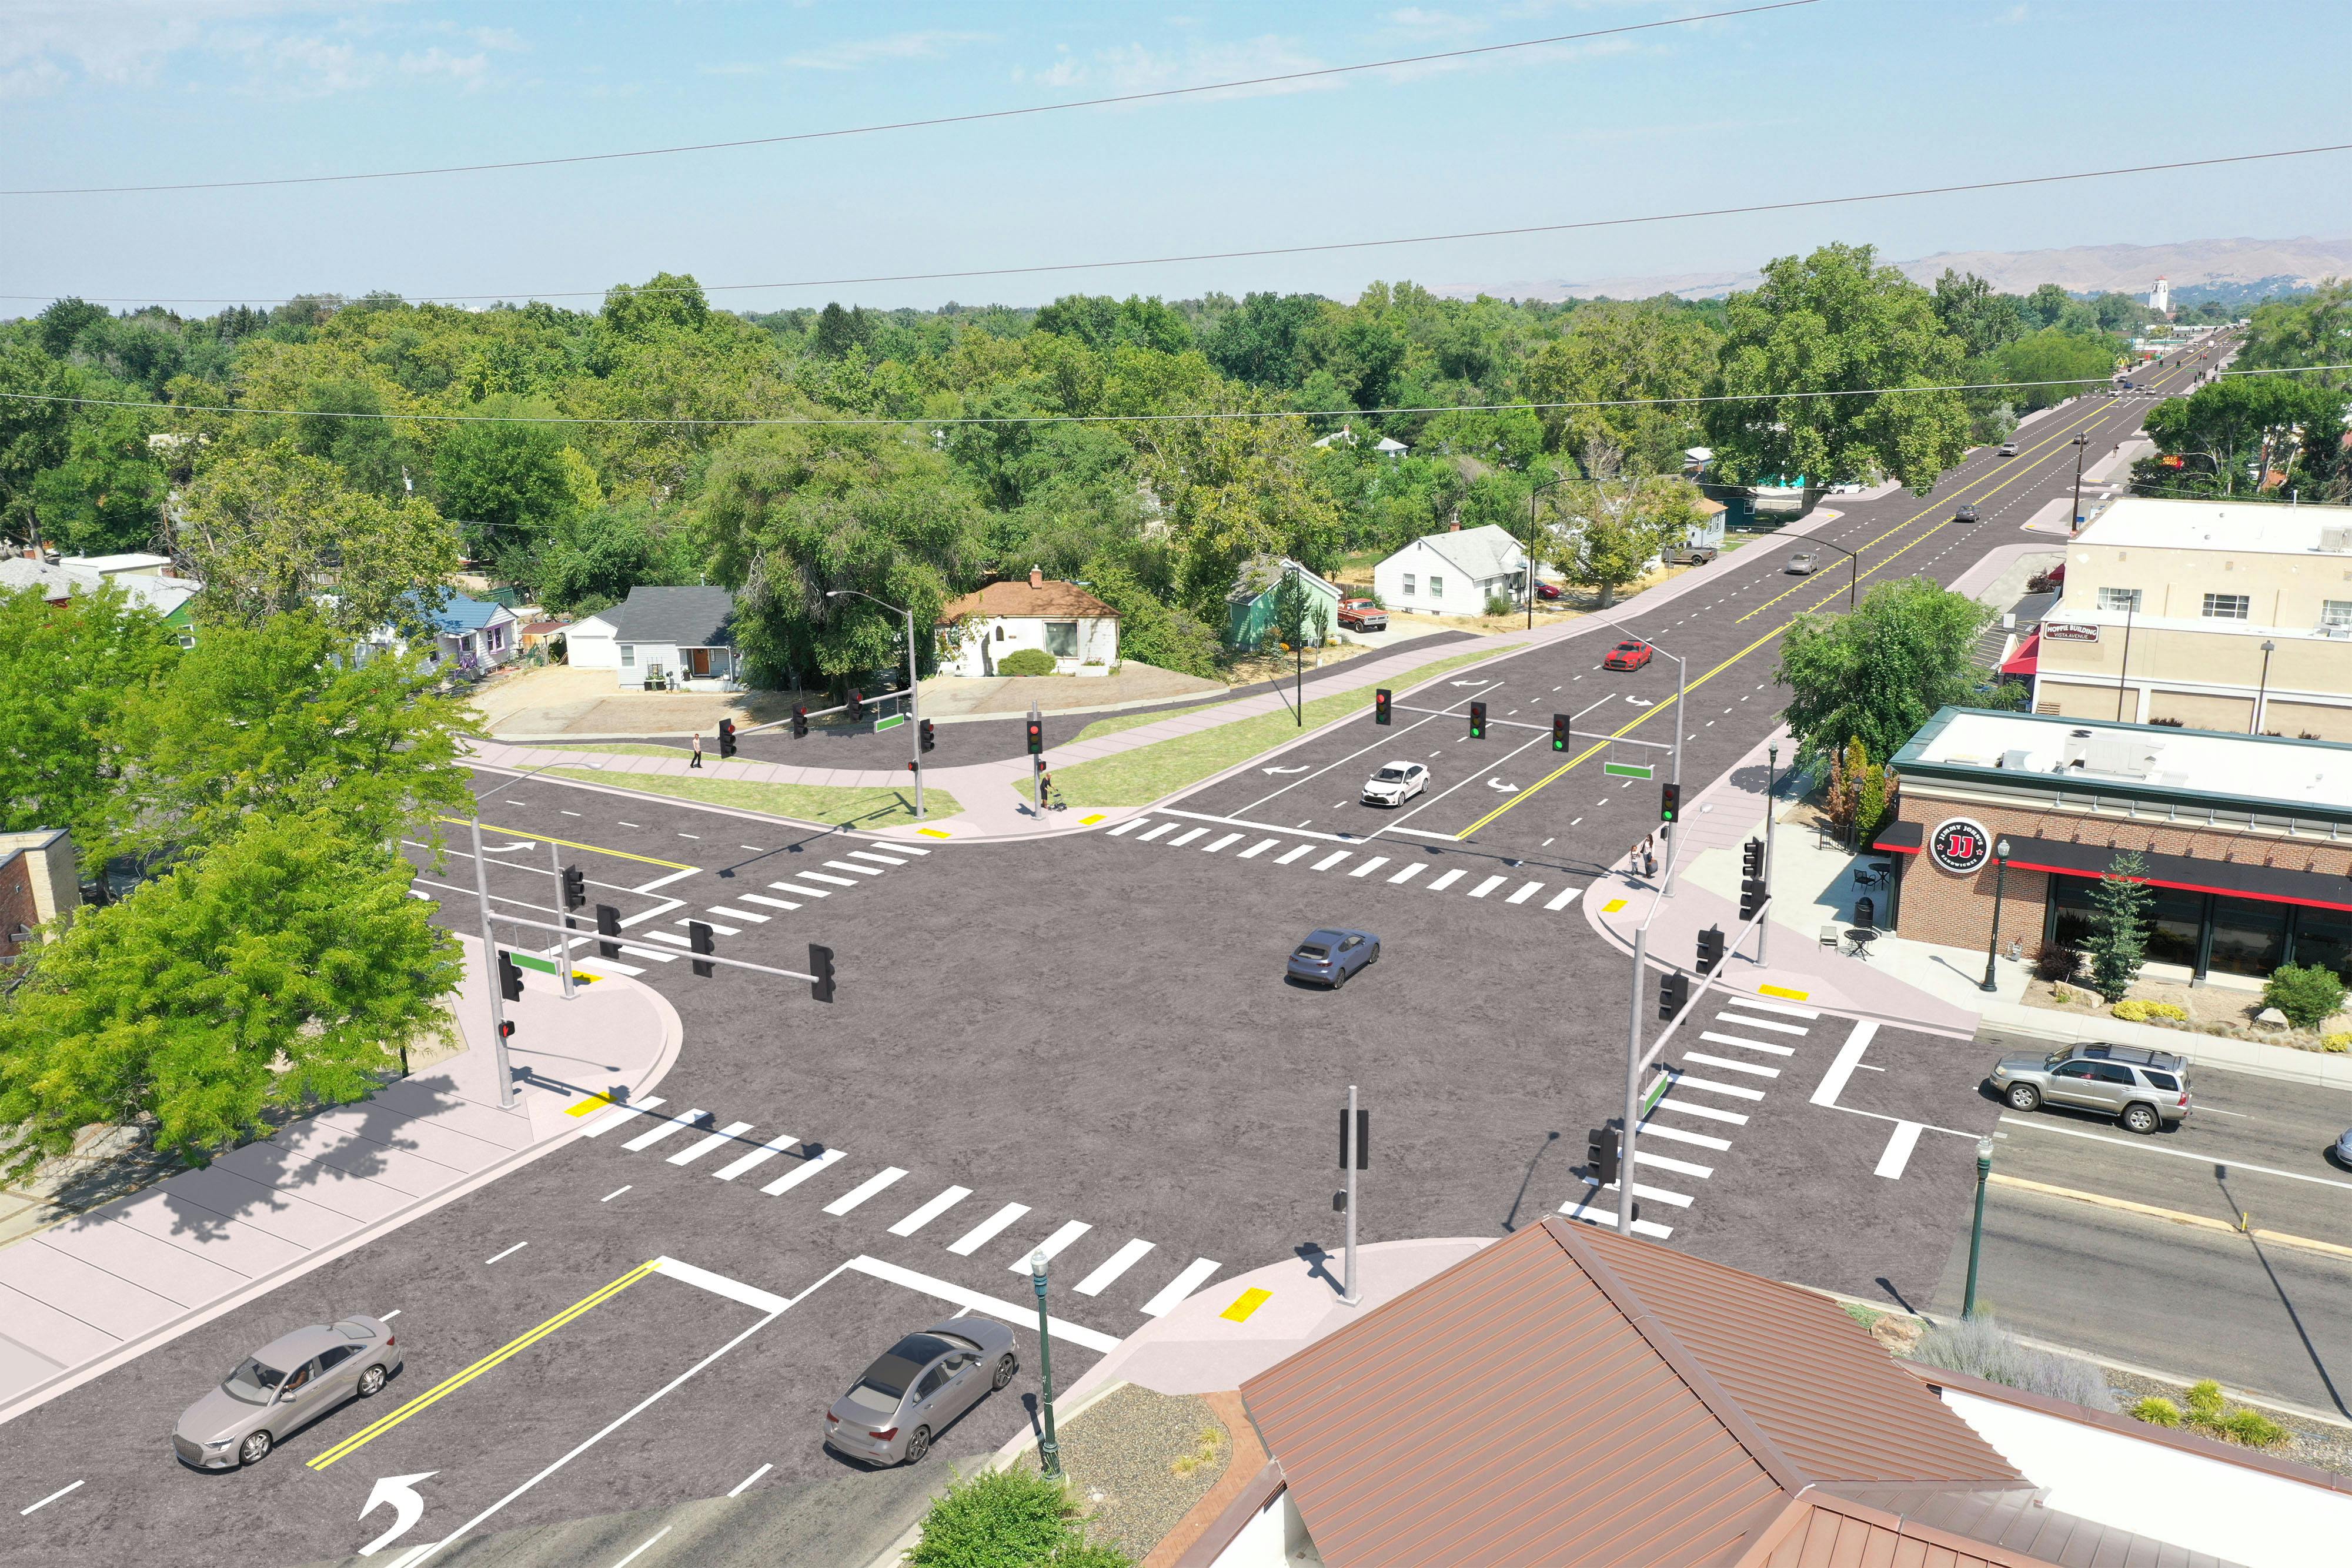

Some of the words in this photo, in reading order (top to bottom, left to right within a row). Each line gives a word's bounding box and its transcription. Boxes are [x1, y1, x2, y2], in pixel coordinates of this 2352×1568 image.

[2070, 625, 2096, 635] BUILDING
[1939, 825, 1961, 841] JIMMY
[1963, 825, 1983, 845] JOHN'S
[1947, 834, 1973, 858] JJ
[1941, 854, 1977, 867] SANDWICHES
